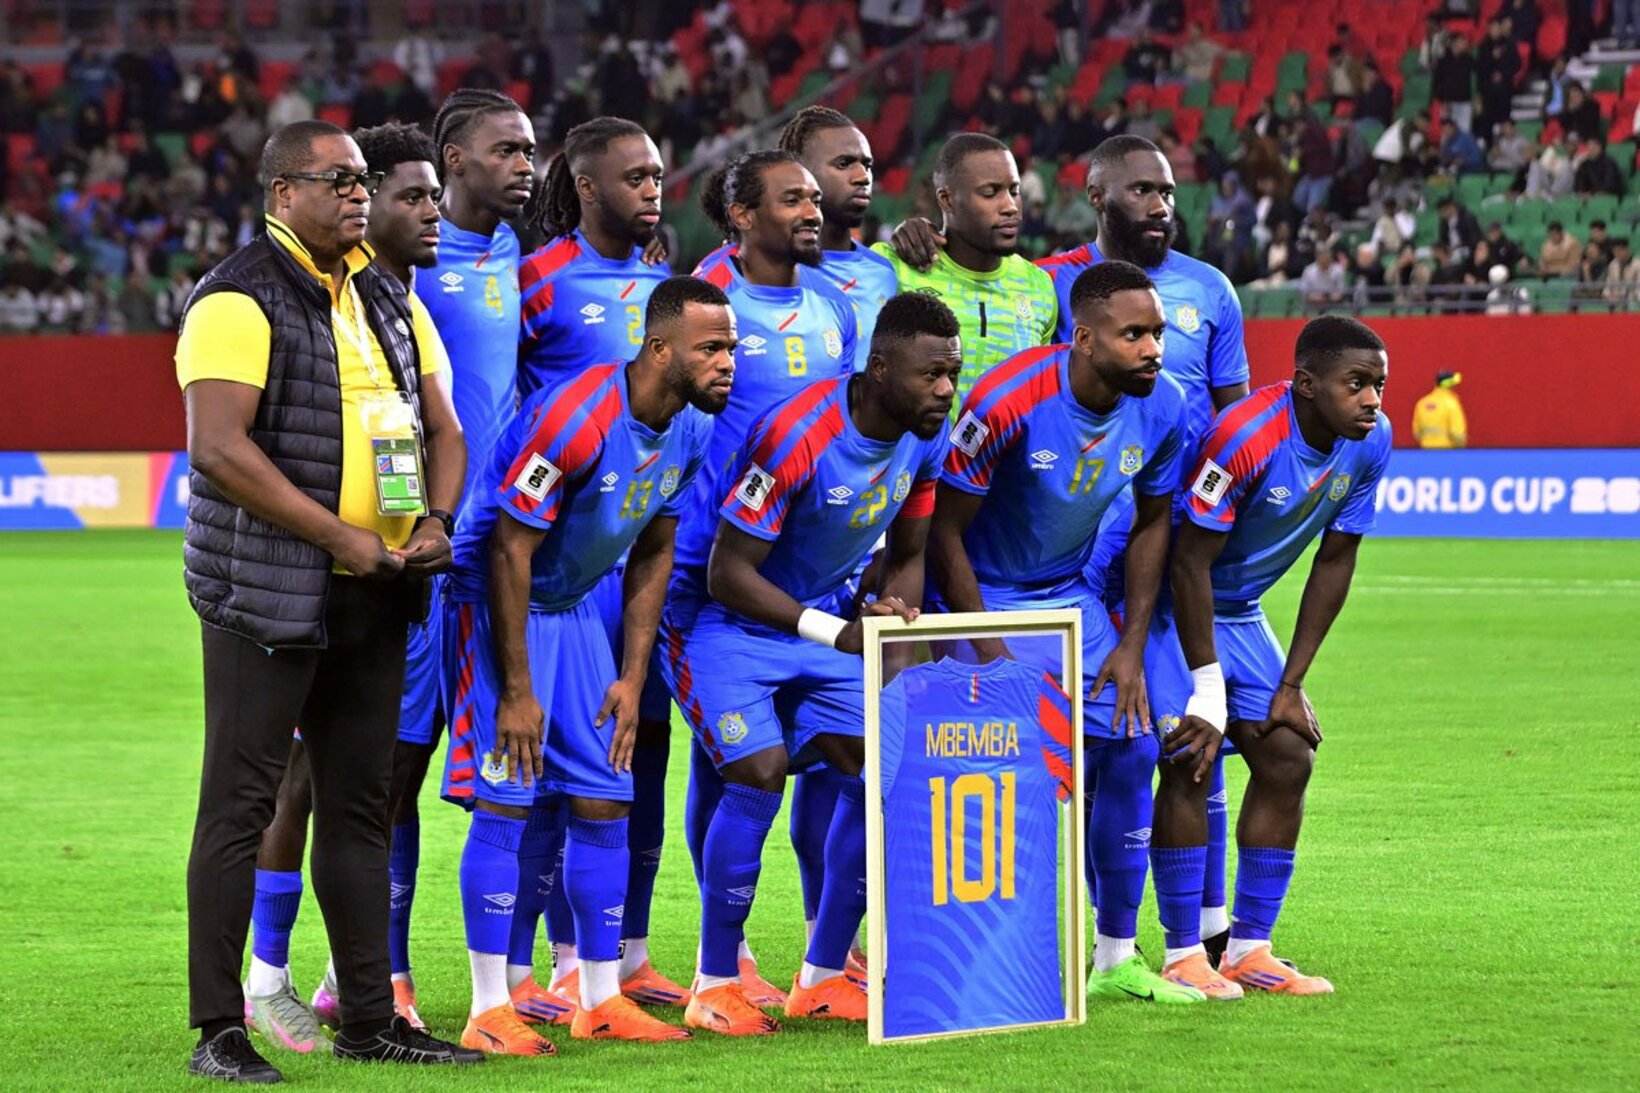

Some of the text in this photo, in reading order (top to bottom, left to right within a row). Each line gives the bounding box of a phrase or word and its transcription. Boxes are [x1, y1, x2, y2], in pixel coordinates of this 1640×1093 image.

[485, 275, 504, 317] 4
[625, 305, 644, 345] 2
[978, 301, 988, 338] 1
[785, 336, 807, 377] 8
[1069, 459, 1105, 495] 17
[1491, 476, 1566, 513] CUP
[620, 481, 654, 520] 13
[850, 485, 888, 529] 22
[926, 722, 1020, 758] MBEMBA
[929, 771, 1017, 906] 101
